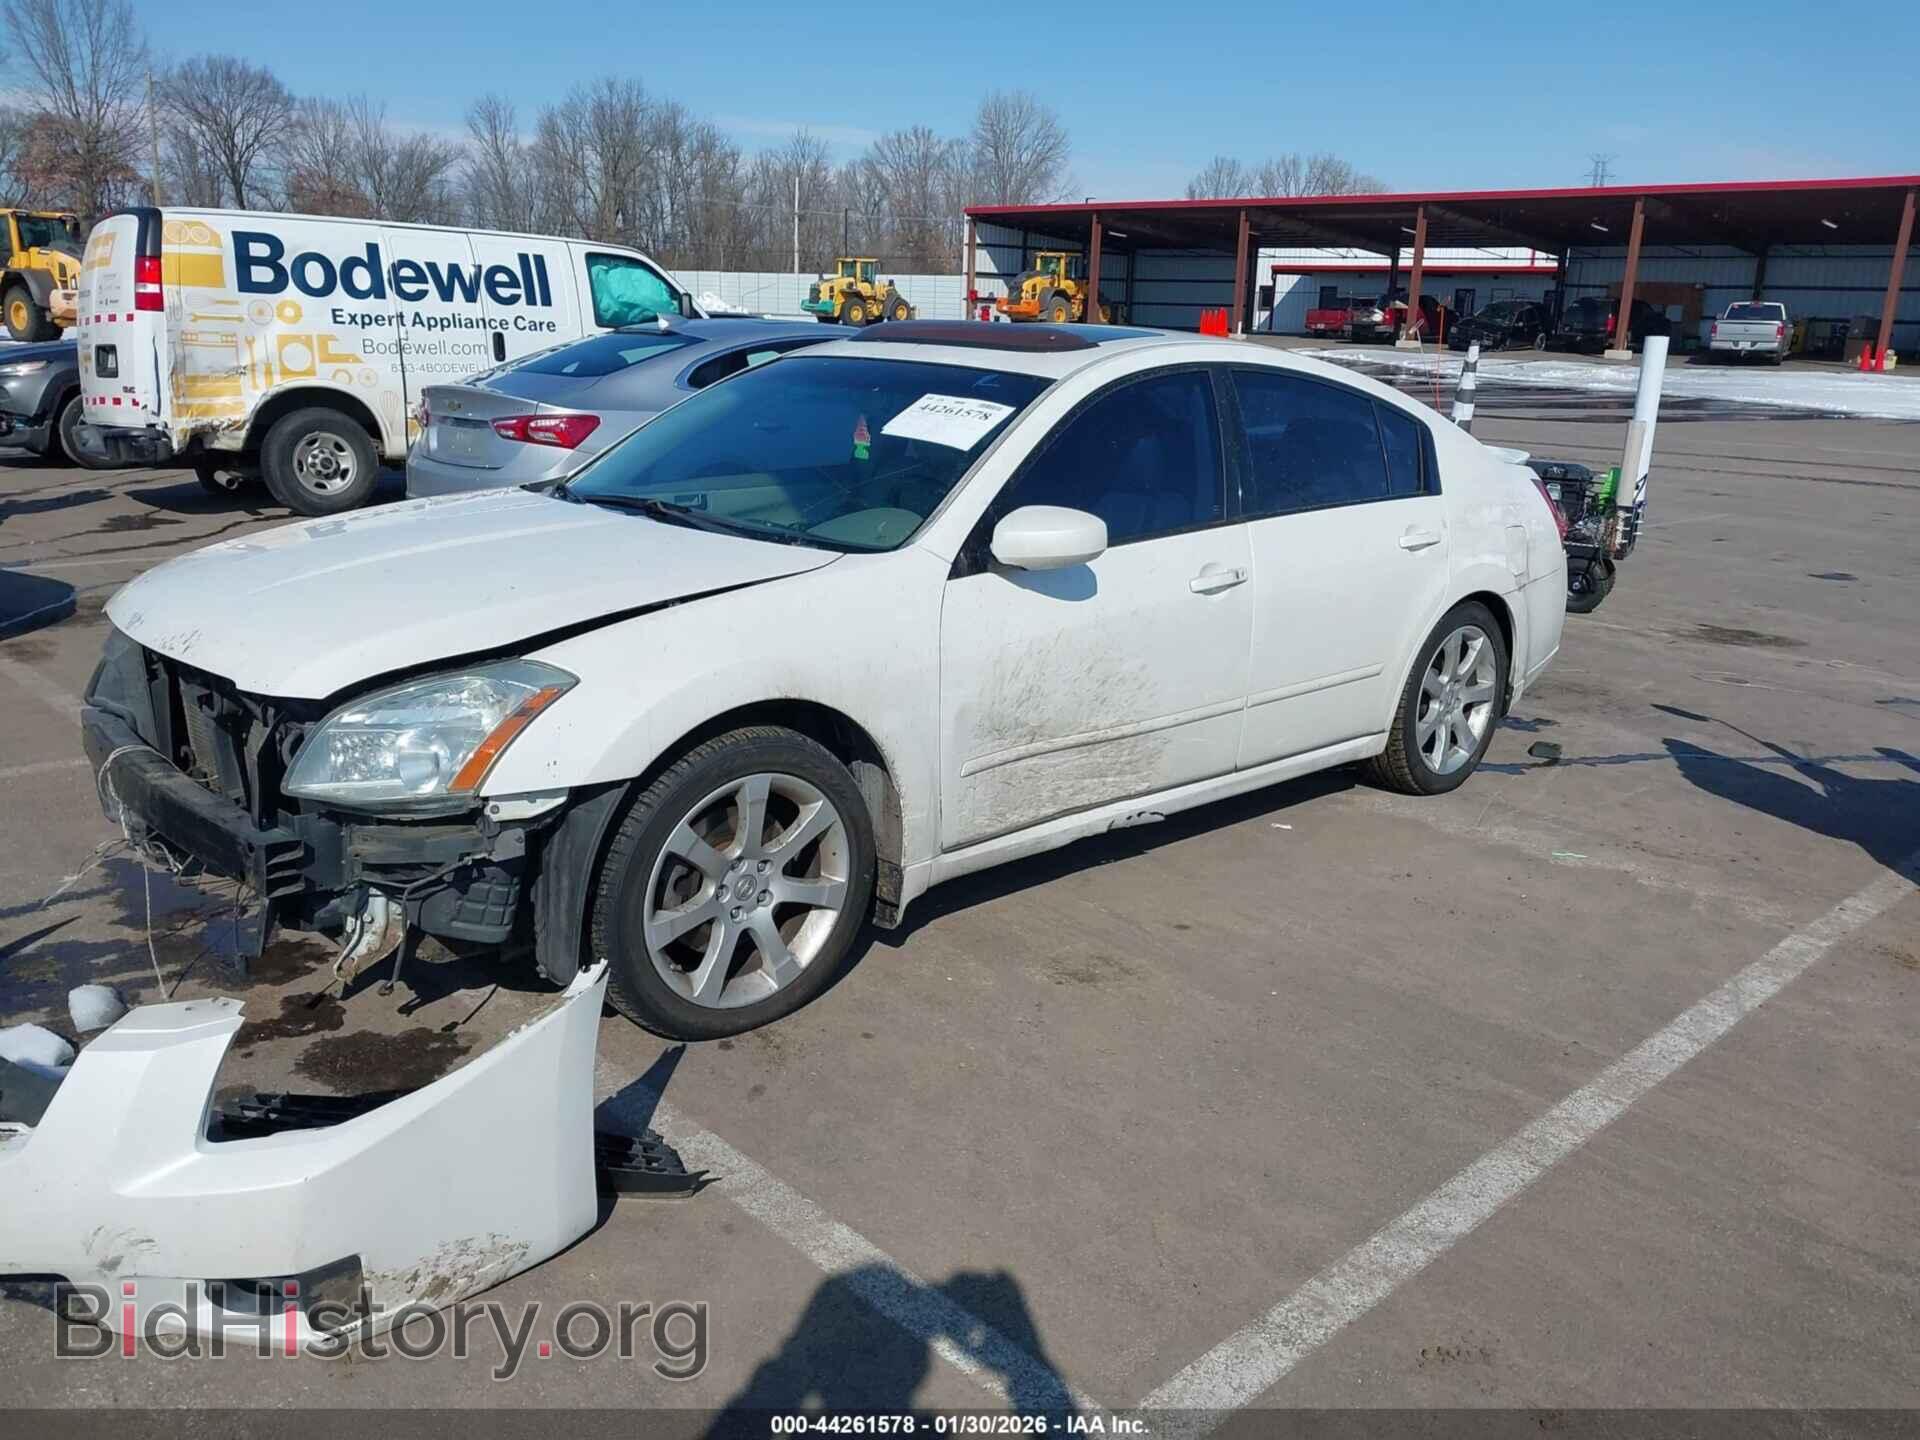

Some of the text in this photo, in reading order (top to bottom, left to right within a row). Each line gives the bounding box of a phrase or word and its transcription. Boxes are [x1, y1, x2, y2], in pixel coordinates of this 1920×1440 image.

[231, 230, 553, 307] Bodewell
[331, 308, 557, 333] Expert Appliance Care
[361, 337, 488, 357] Bodewell.com
[920, 403, 992, 420] 44261578
